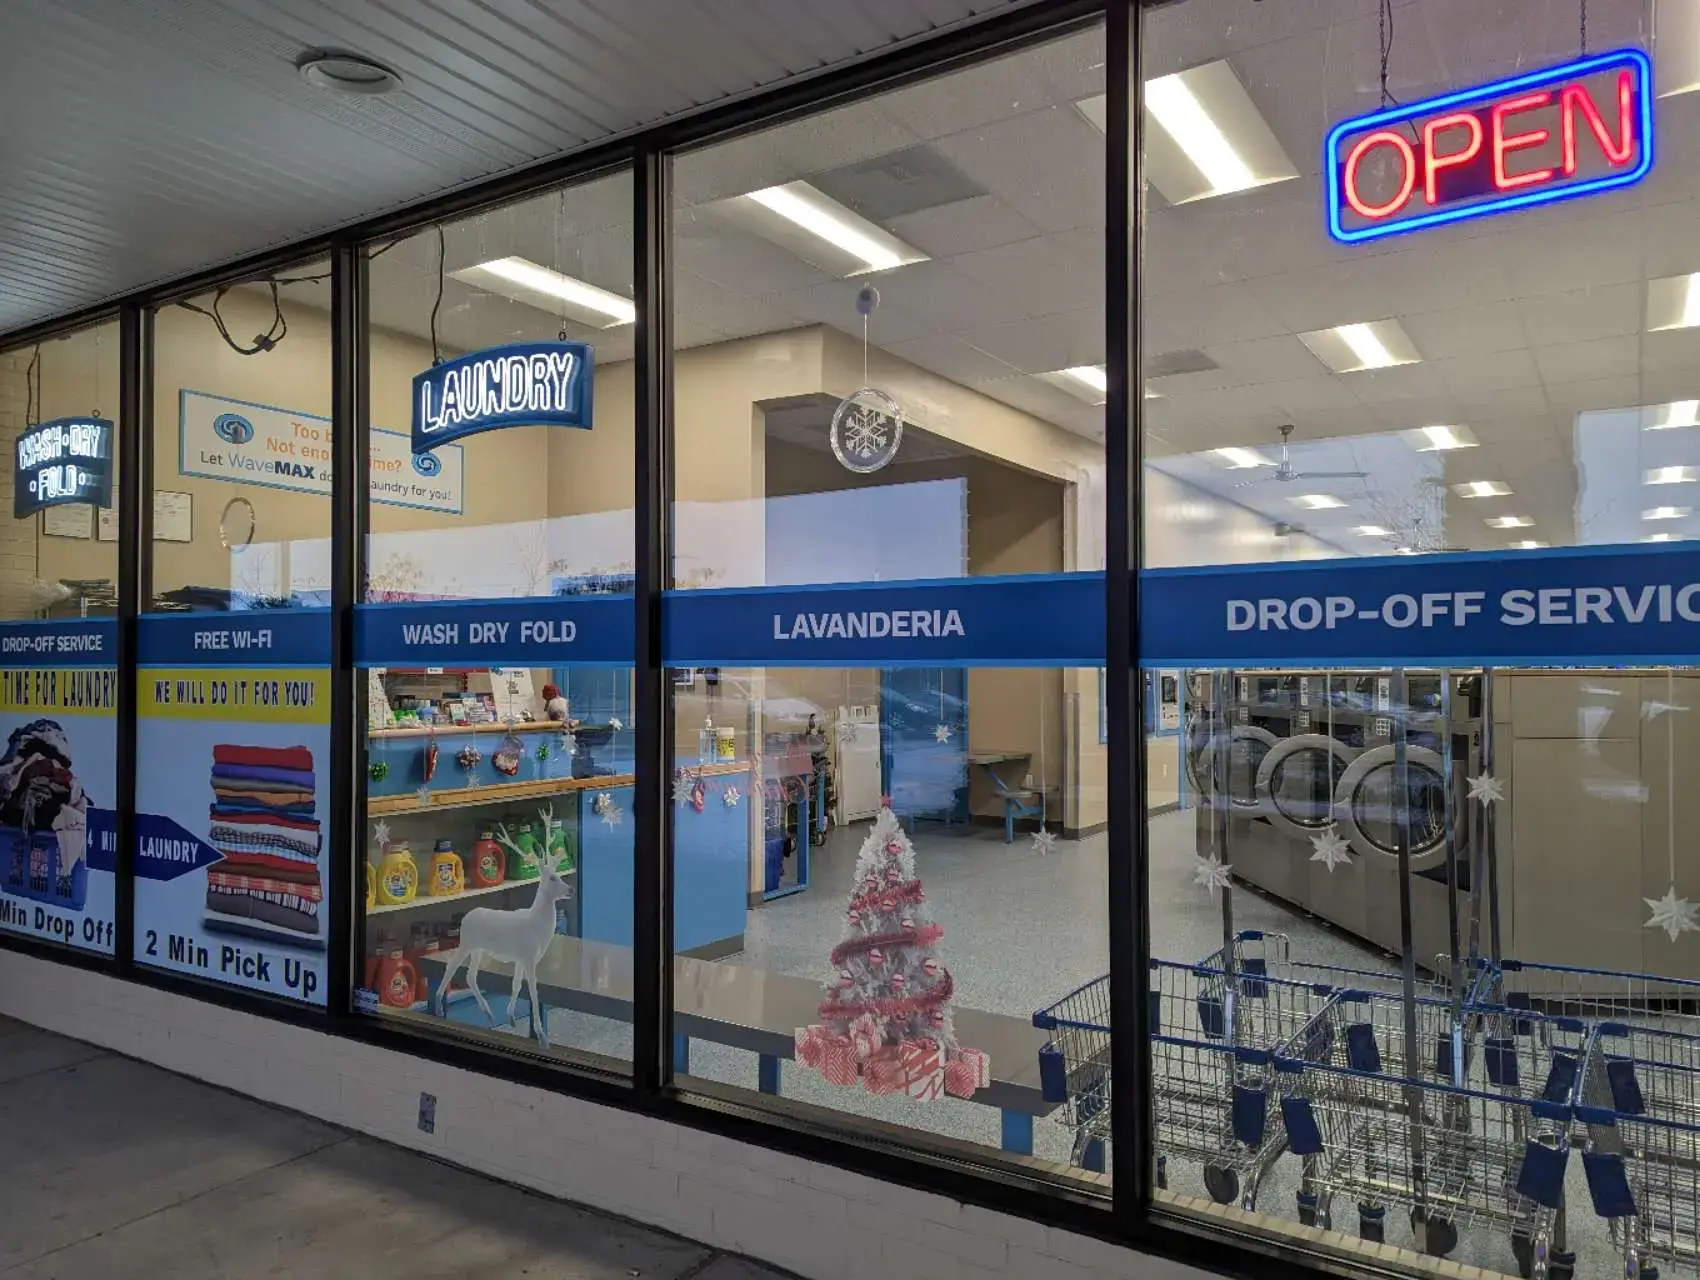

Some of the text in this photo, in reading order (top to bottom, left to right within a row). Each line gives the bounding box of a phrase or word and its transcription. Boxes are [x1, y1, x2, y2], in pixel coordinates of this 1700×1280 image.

[1343, 71, 1635, 219] OPEN
[421, 352, 573, 433] LAUNDRY
[18, 424, 101, 470] WASH DRY
[291, 421, 319, 441] Too
[266, 436, 401, 472] Not eno me?
[38, 464, 77, 501] FOLD
[200, 450, 223, 466] Let
[228, 452, 315, 480] WaveMAX
[371, 480, 408, 497] aundry
[411, 484, 426, 496] for
[773, 609, 966, 640] LAVANDERIA
[1226, 590, 1486, 632] DROP-OFF
[2, 634, 103, 653] DROP-OFF SERVICE
[194, 629, 272, 650] FREE WI-FI
[402, 621, 577, 645] WASH DRY FOLD
[4, 670, 117, 709] TIME FOR LAUNDRY
[155, 680, 315, 707] WE WILL DO IT FOR YOU!
[139, 835, 199, 864] LAUNDRY
[0, 898, 113, 946] Min Drop Off
[145, 929, 317, 998] 2 Min Pick Up
